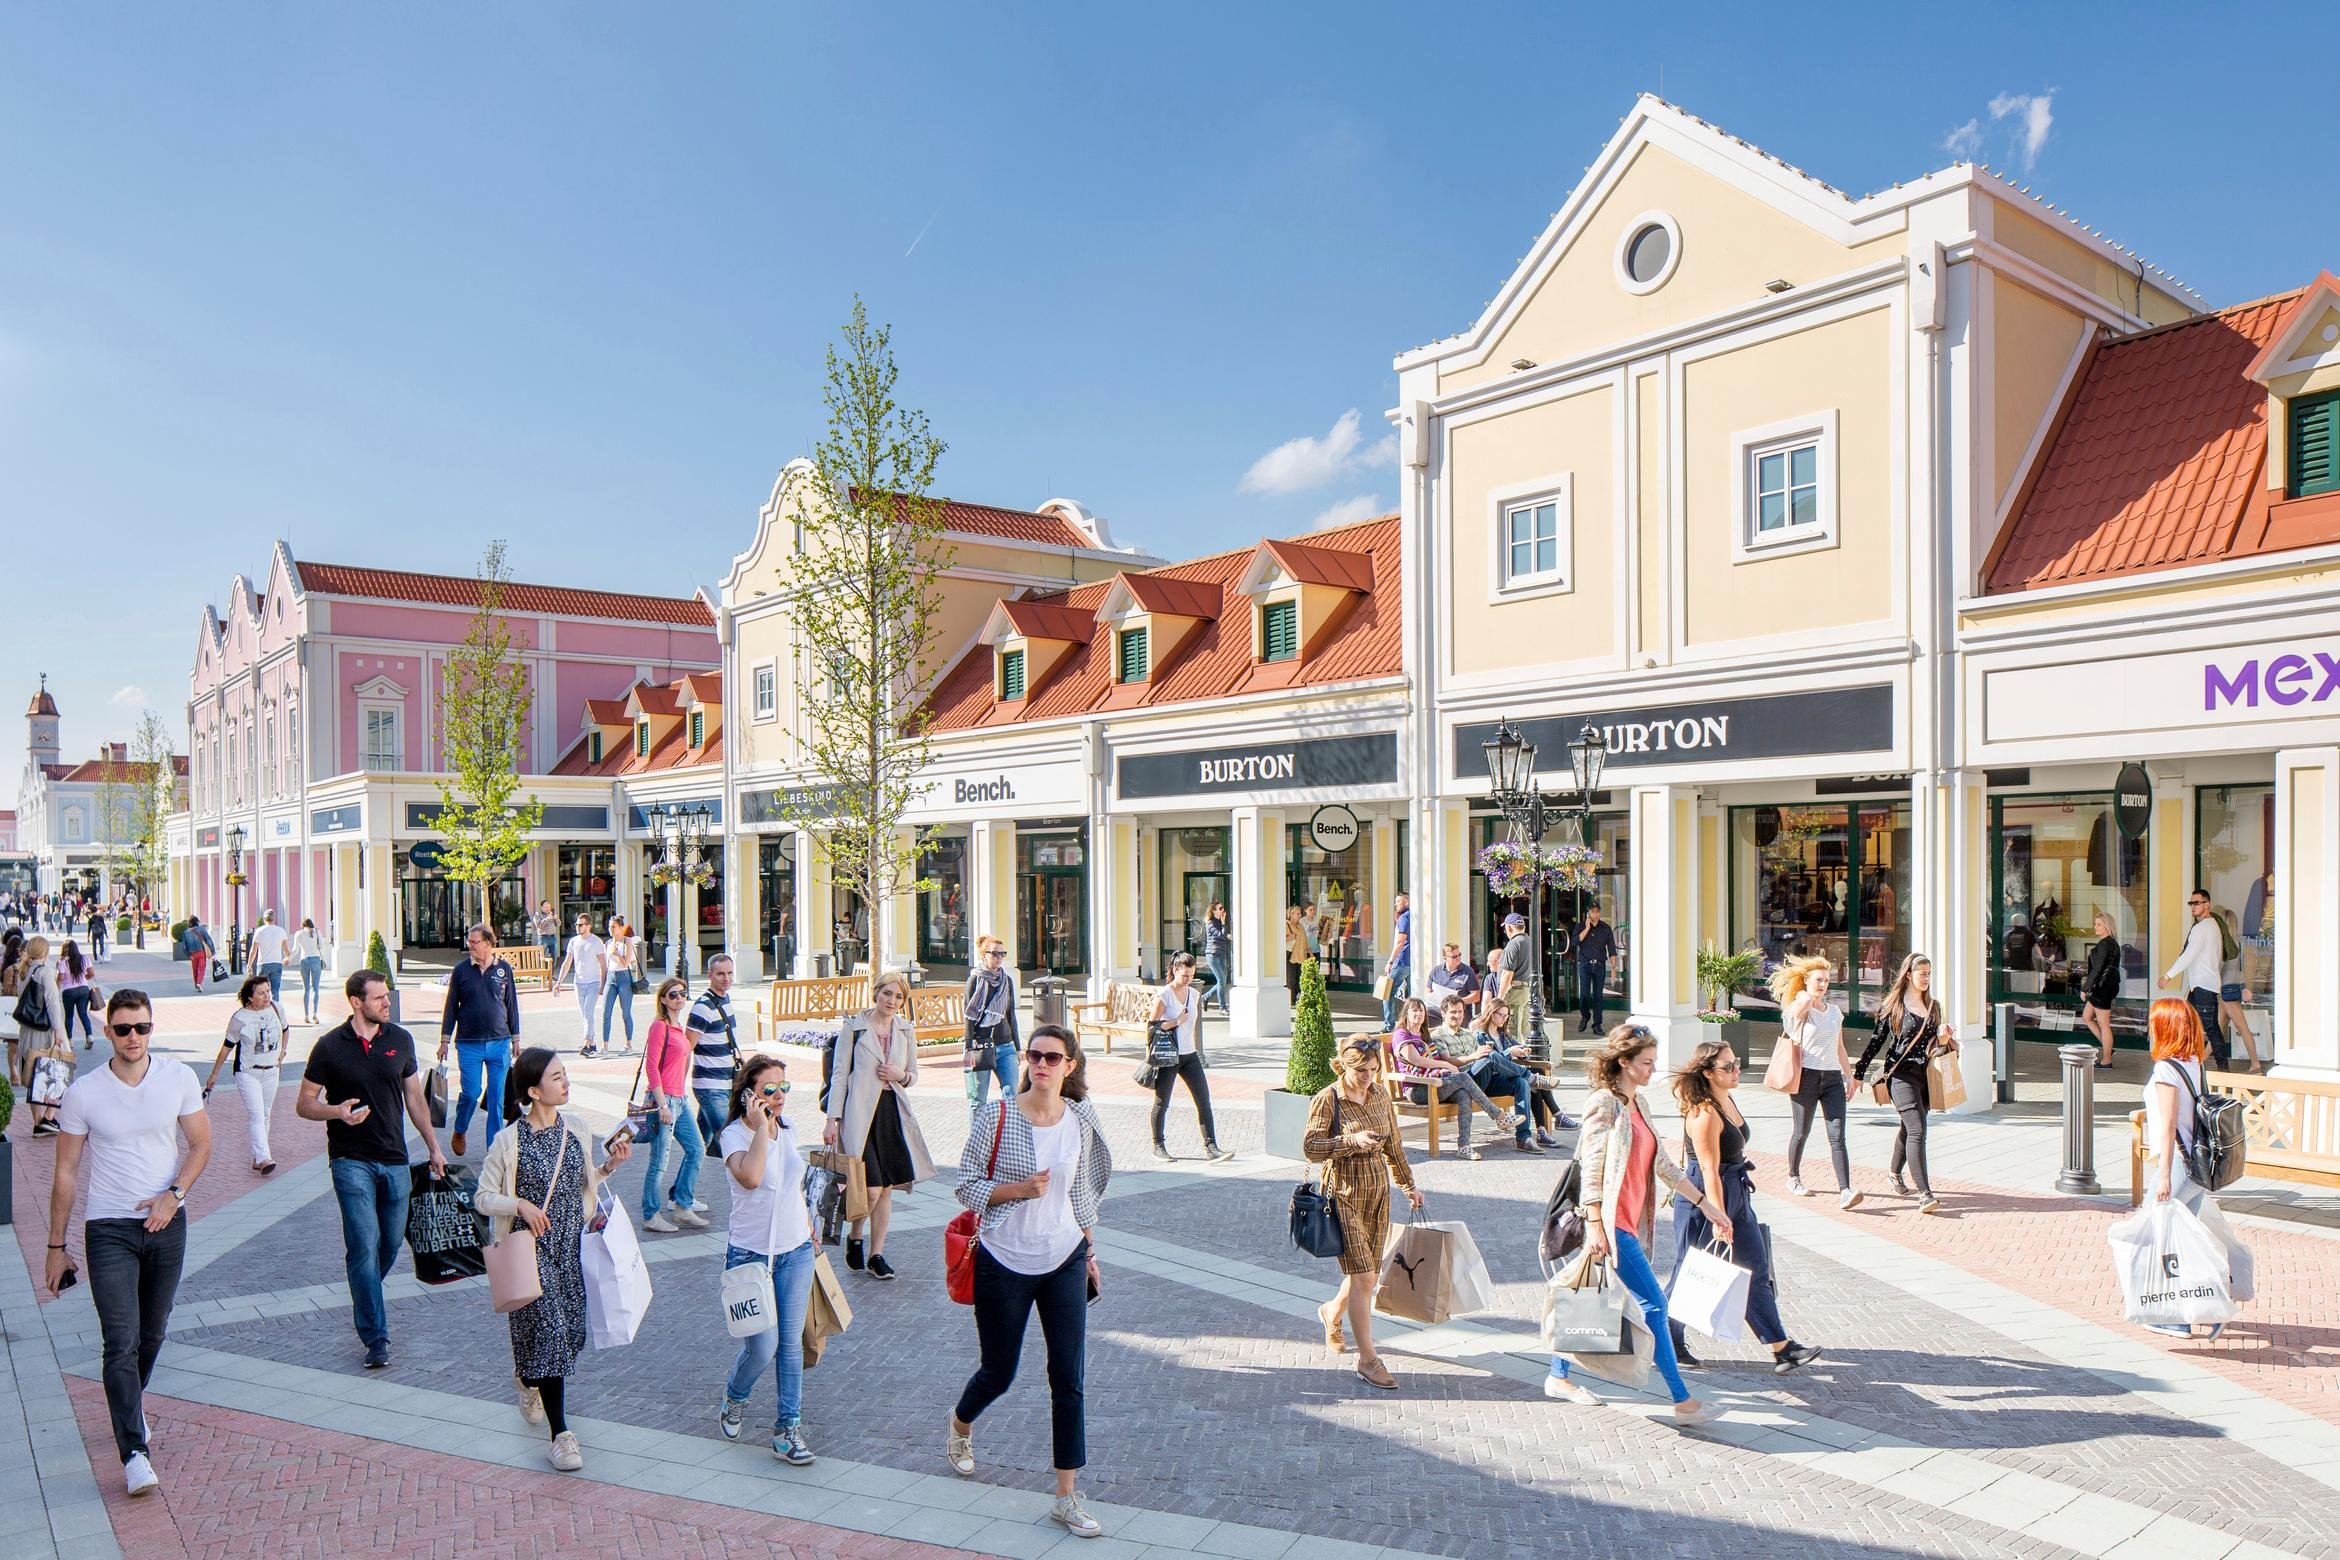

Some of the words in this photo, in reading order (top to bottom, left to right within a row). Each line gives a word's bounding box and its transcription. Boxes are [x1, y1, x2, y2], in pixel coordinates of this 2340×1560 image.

[1581, 716, 1728, 754] URTON
[1200, 754, 1294, 783] BURTON
[955, 775, 1015, 803] Bench.
[2121, 794, 2147, 807] BURTON
[1316, 822, 1353, 834] Bench.
[433, 1202, 458, 1216] WAS
[423, 1226, 457, 1240] MAKE
[431, 1235, 480, 1253] BETTER.
[2140, 1291, 2176, 1306] pierre
[2180, 1285, 2214, 1299] ardin
[729, 1298, 760, 1322] NIKE
